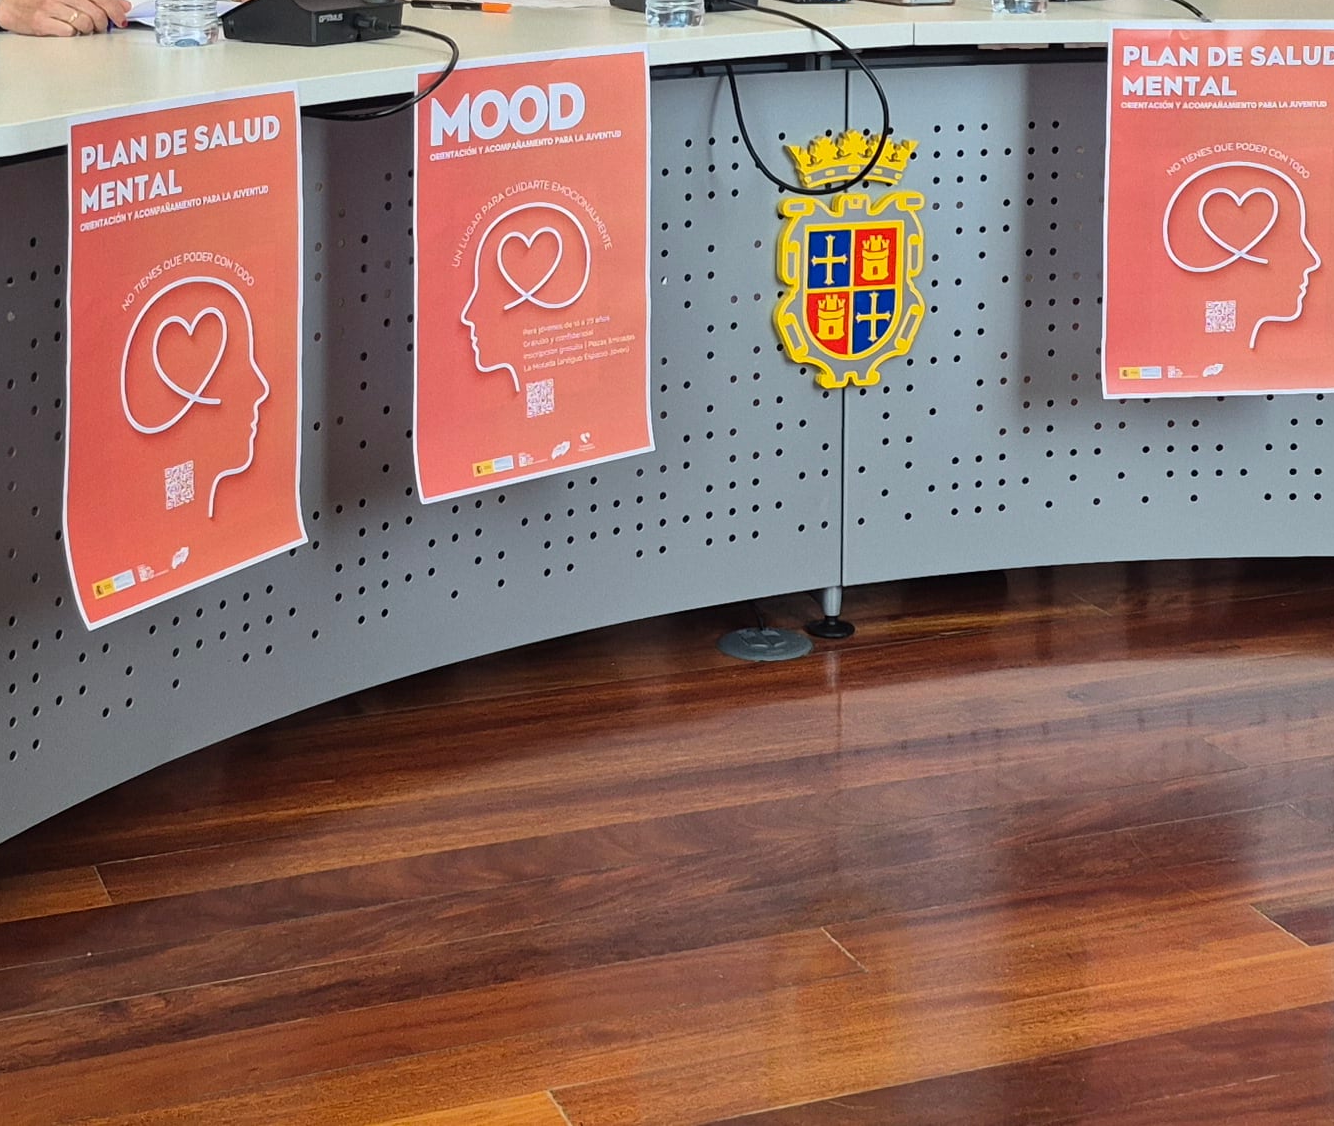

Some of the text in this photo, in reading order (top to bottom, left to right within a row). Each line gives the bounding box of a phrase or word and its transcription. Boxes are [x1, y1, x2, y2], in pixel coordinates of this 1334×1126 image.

[1123, 46, 1199, 66] PLAN
[1208, 46, 1243, 66] DE
[1121, 101, 1174, 109] ORIENTACIÓN
[1182, 101, 1256, 109] ACOMPAÑAMIENTO
[1123, 76, 1237, 96] MENTAL
[430, 82, 585, 146] MOOD
[81, 115, 280, 173] PLAN DE SALUD
[429, 147, 477, 161] ORIENTACIÓN
[484, 137, 553, 153] ACOMPAÑAMIENTO
[555, 135, 573, 145] PARA
[574, 134, 584, 142] LA
[585, 130, 622, 140] JUVENTUD
[1166, 142, 1310, 179] NO TIENES QUE PODER CON TODO
[80, 186, 268, 232] ORIENTACIÓN Y ACOMPAÑAMIENTO PARA LA JUVENTUD
[81, 170, 182, 213] MENTAL
[452, 180, 612, 267] UN LUGAR PARA CUIDARTE EMOCIONALMENTE
[122, 252, 254, 311] NO TIENES QUE PODER CON TODO
